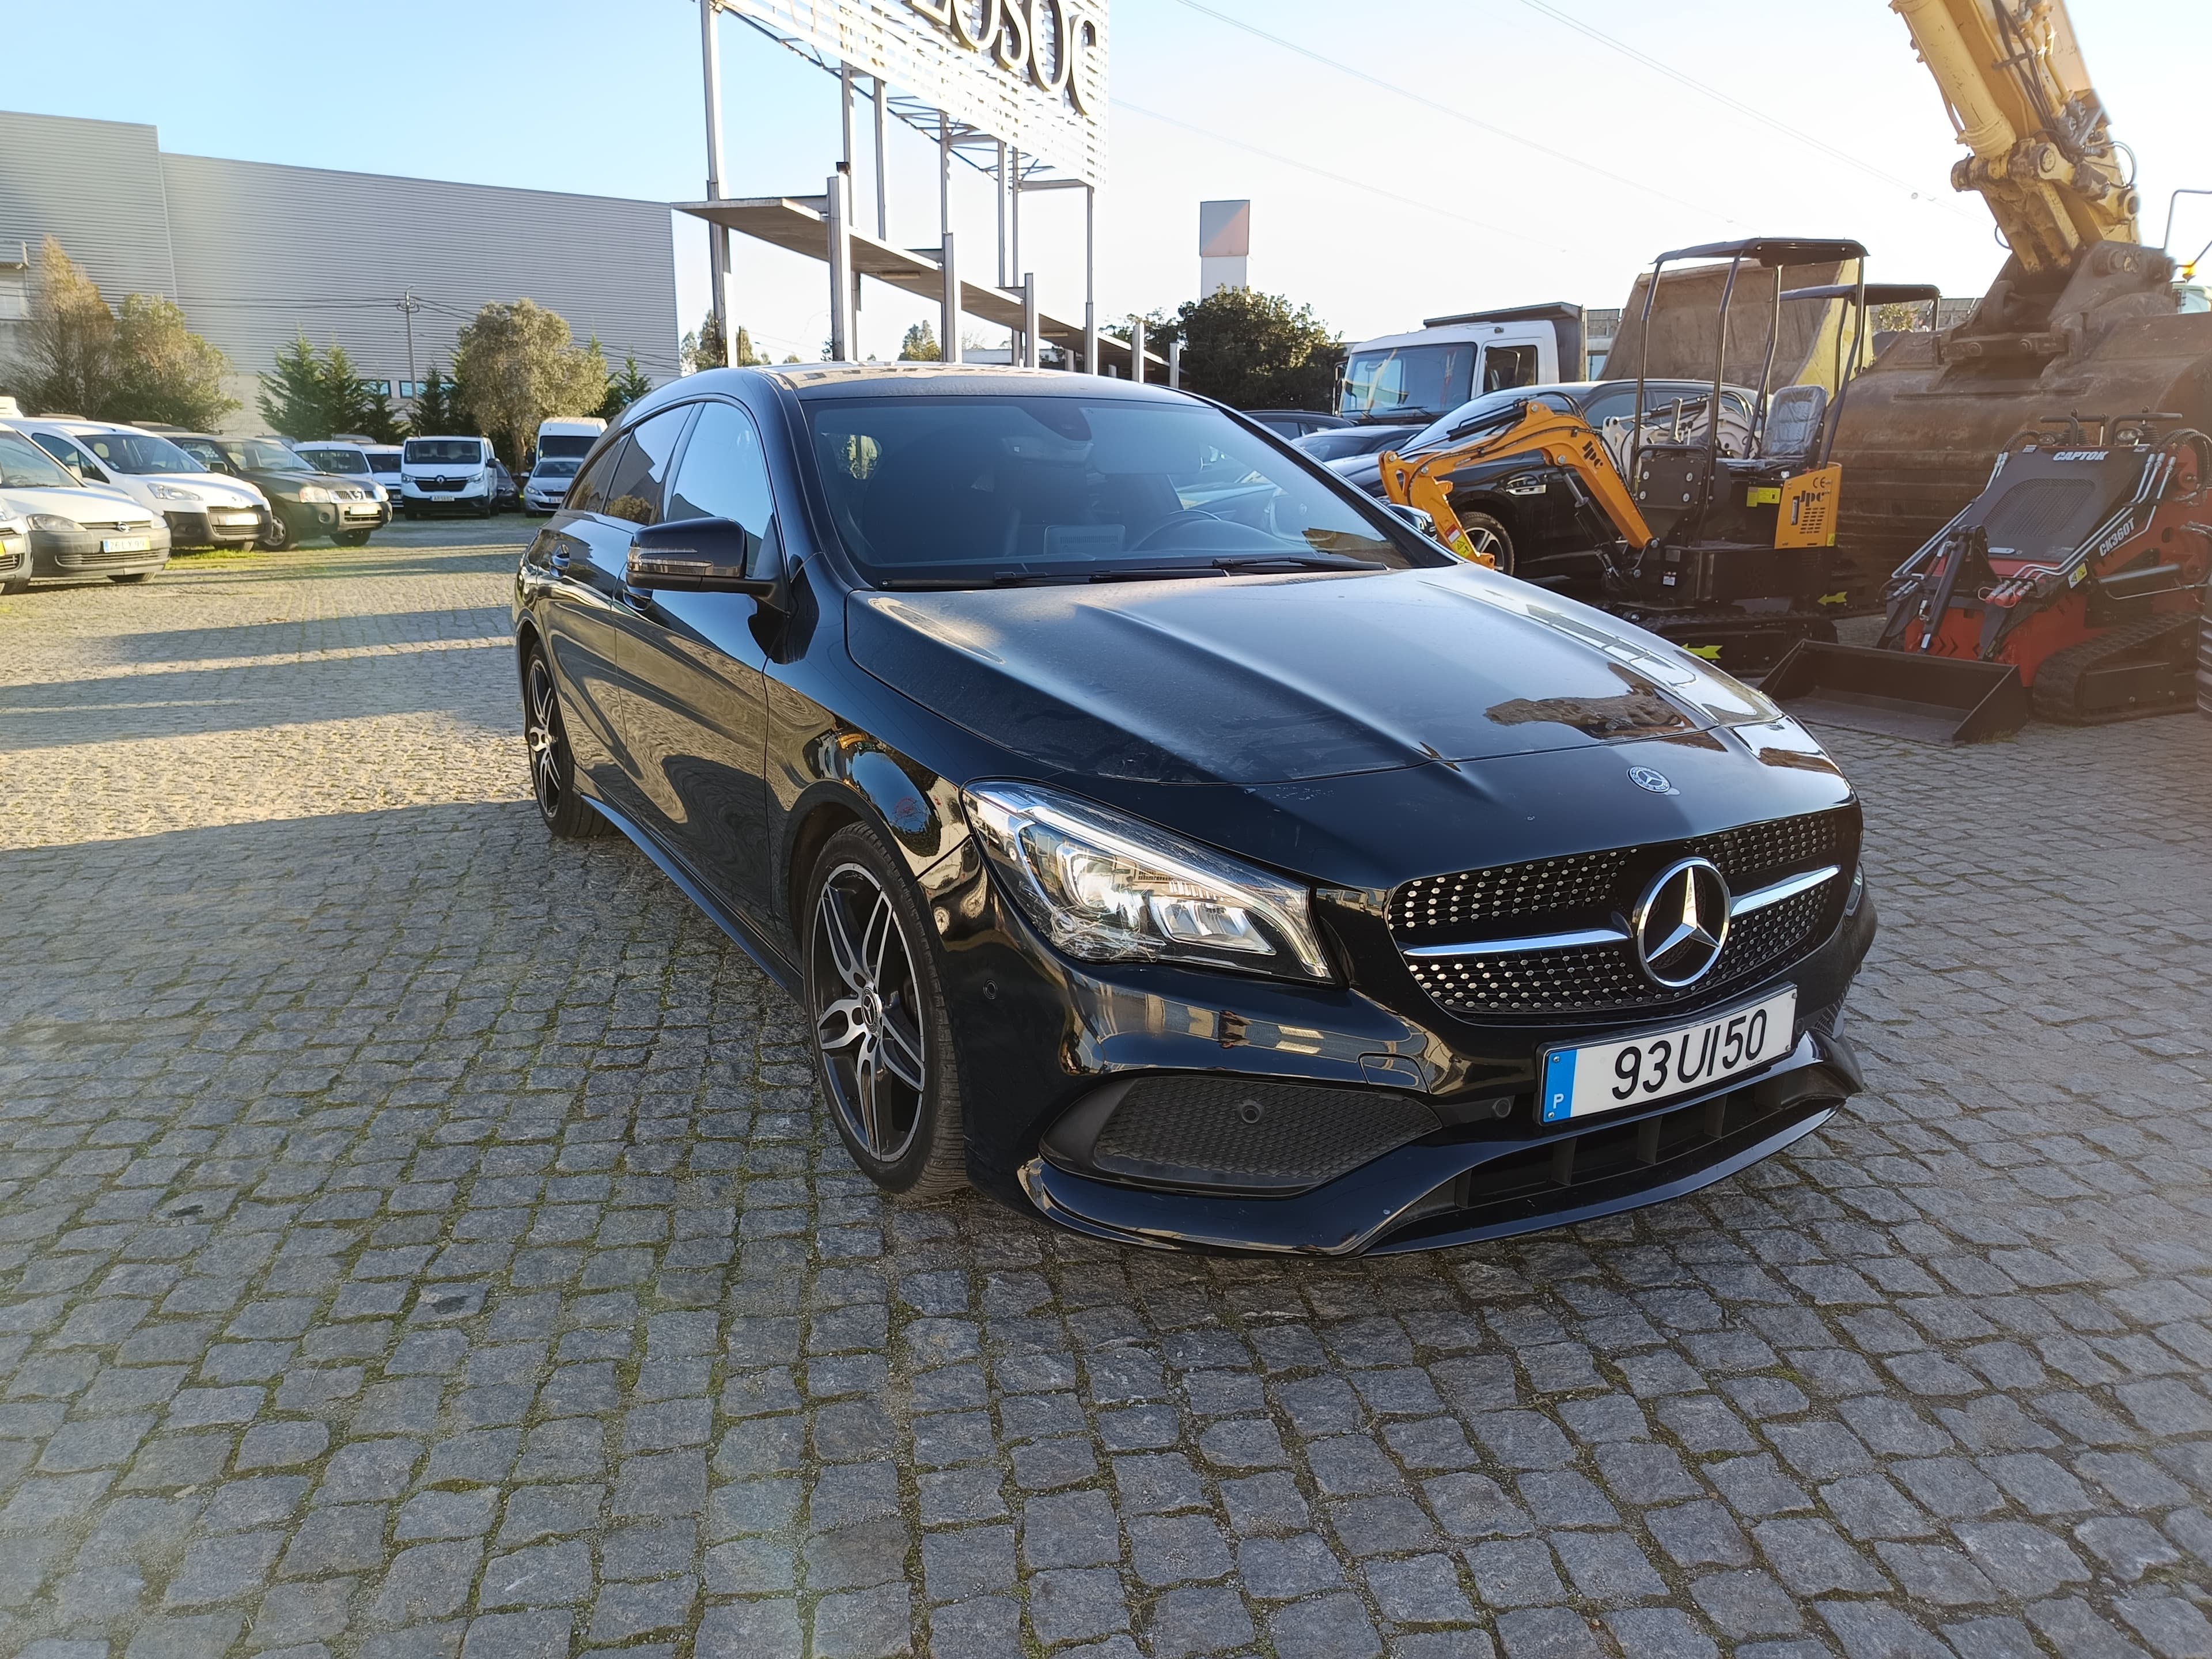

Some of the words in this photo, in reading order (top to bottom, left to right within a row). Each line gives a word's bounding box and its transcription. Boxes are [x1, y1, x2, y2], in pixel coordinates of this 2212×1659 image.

[2052, 451, 2109, 461] CAPTOK
[2099, 517, 2135, 557] CK360T
[1553, 1093, 1564, 1109] P
